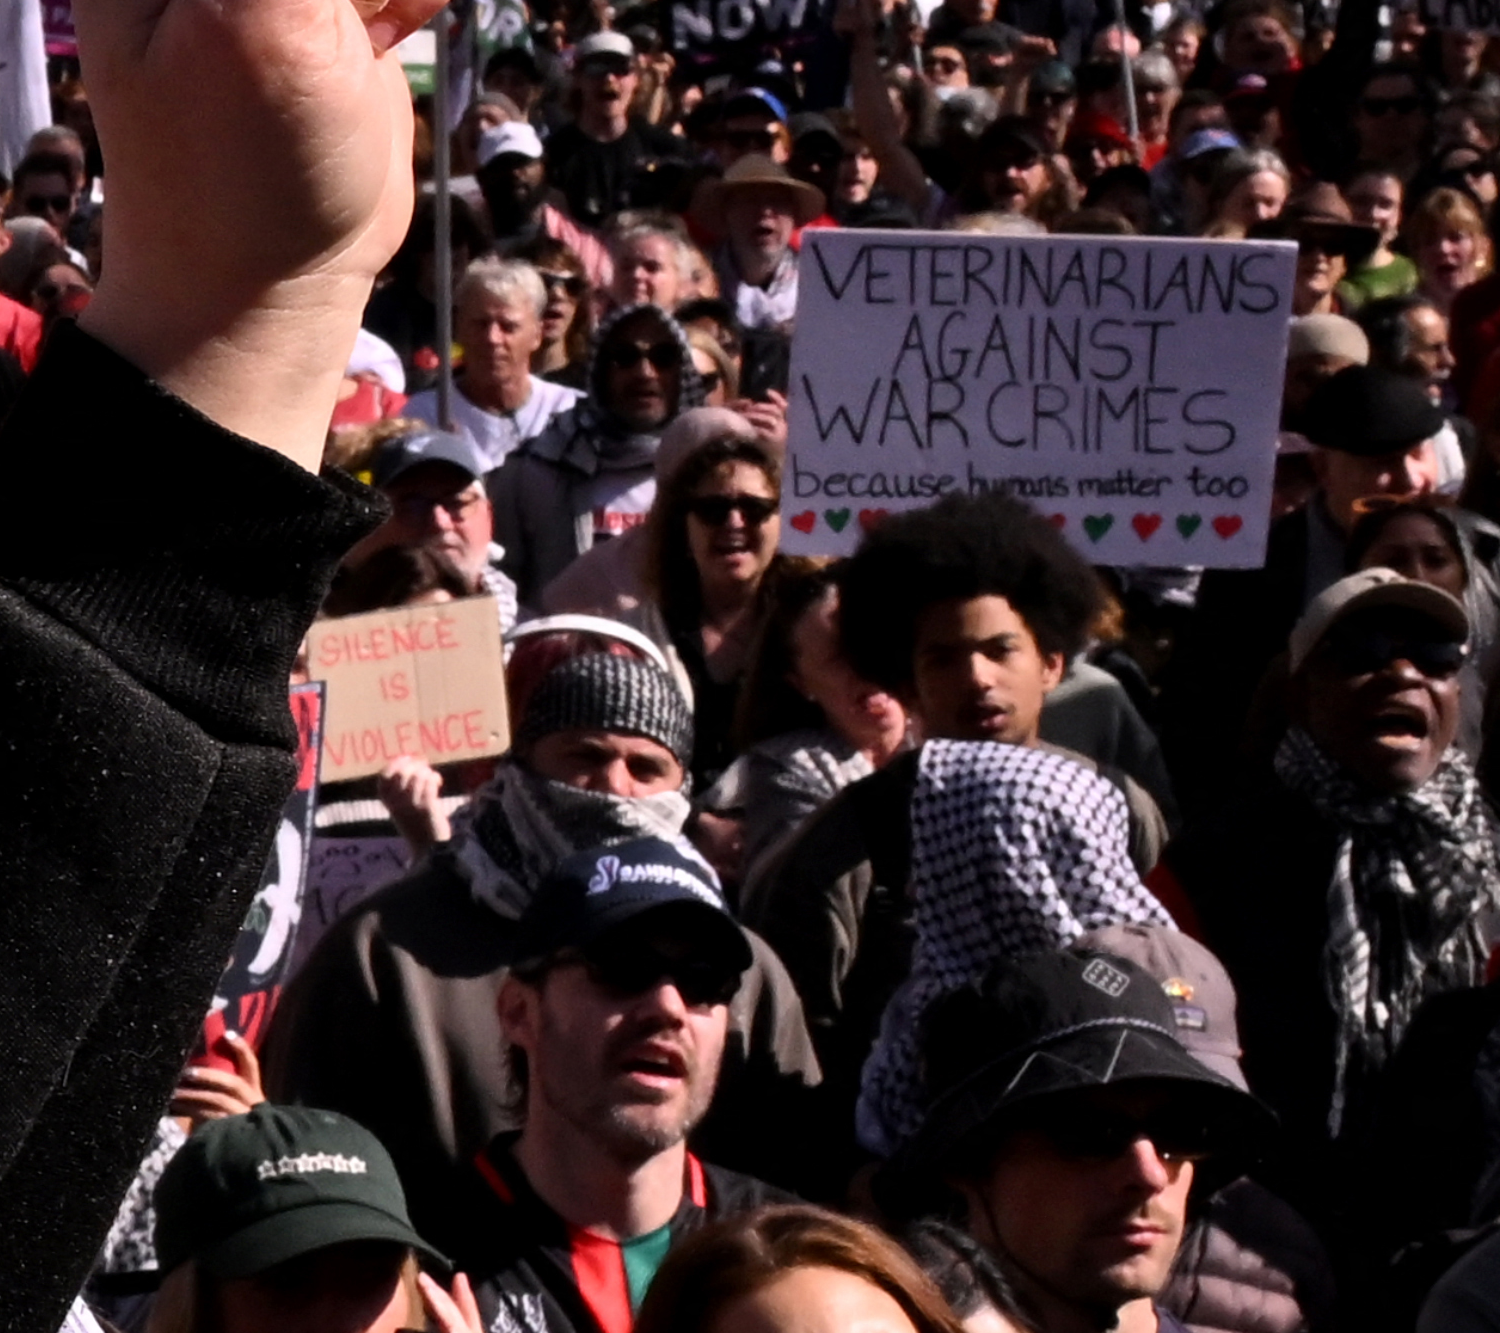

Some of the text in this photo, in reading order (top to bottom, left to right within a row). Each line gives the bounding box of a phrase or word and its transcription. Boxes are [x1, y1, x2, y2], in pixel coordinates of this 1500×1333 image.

[812, 242, 1280, 315] VETERINARIANS
[893, 312, 1176, 382] AGAINST
[802, 373, 1238, 455] WAR CRIMES
[793, 454, 1249, 499] because humans matter too
[318, 618, 461, 667] SILENCE
[380, 673, 410, 703] IS
[323, 710, 488, 767] VIOLENCE
